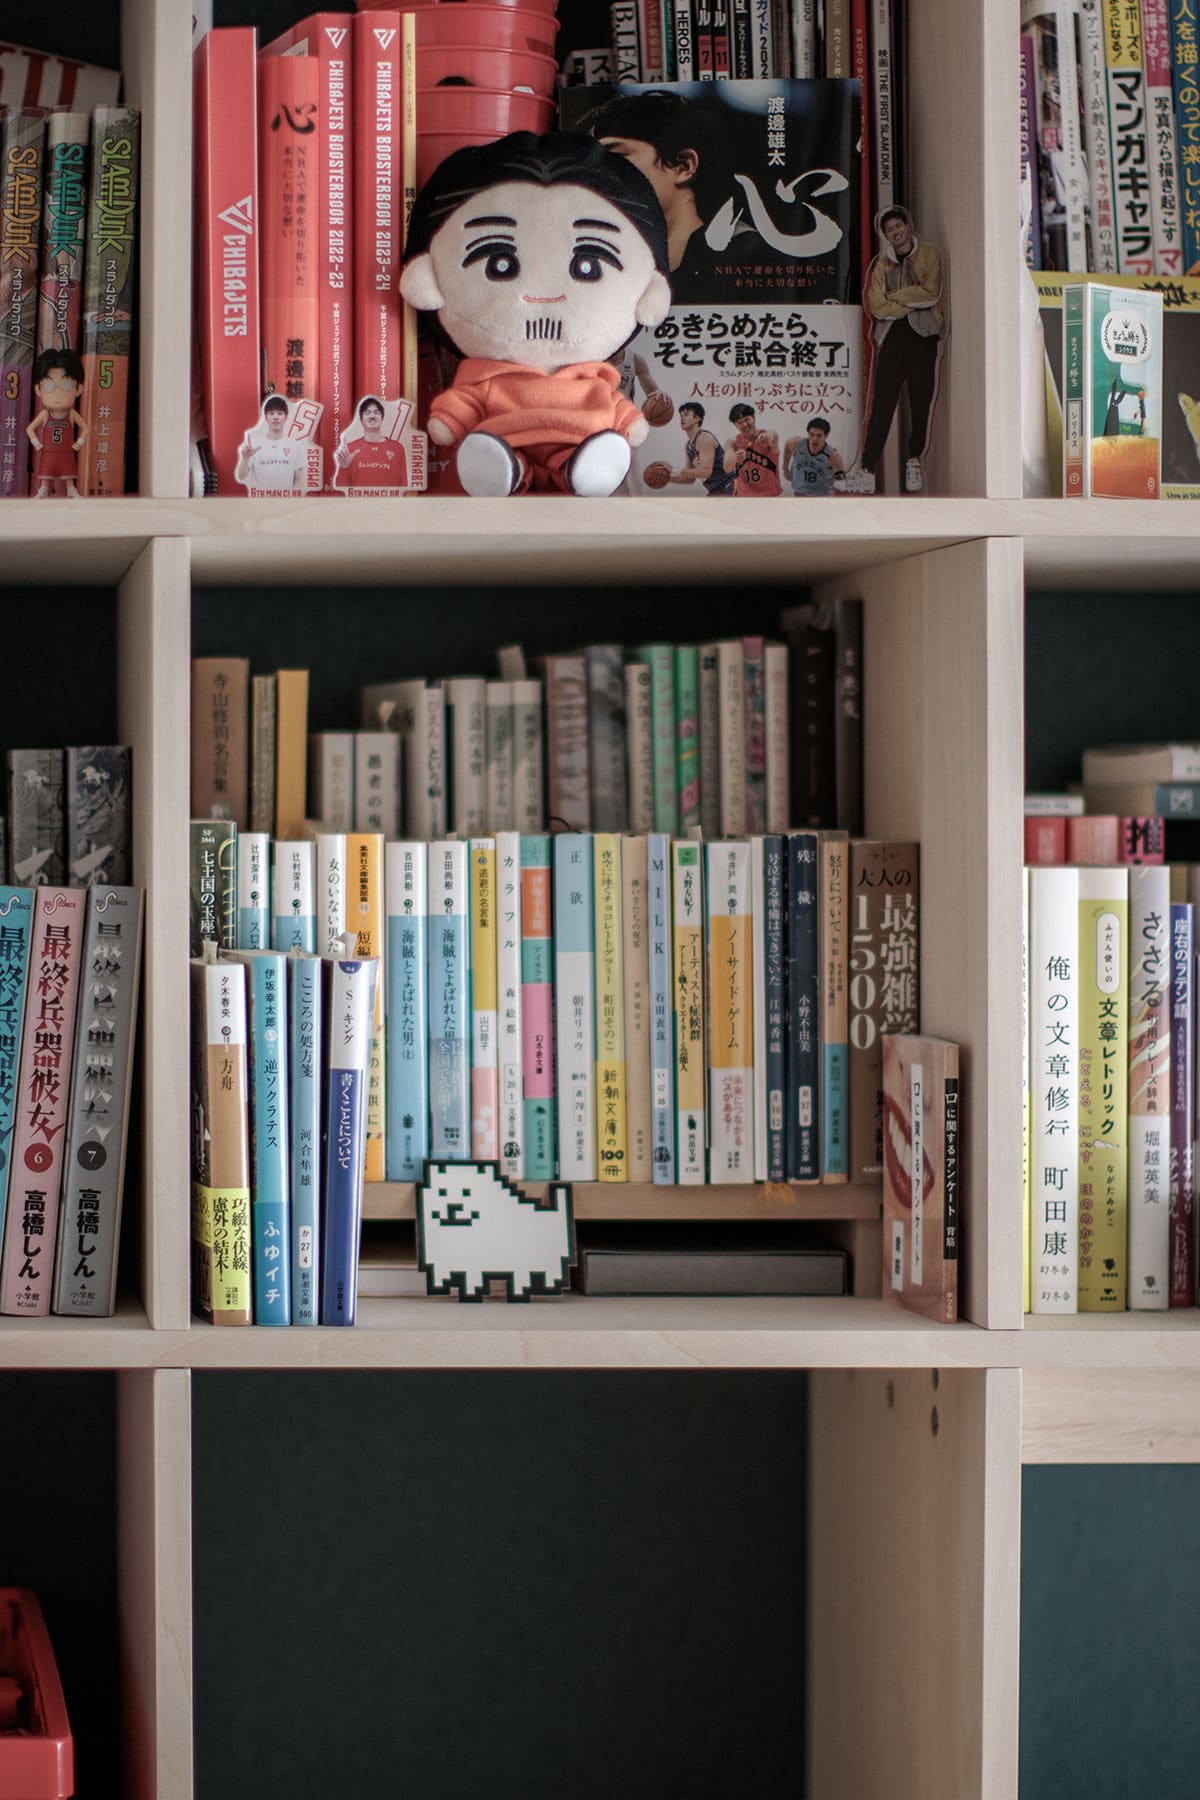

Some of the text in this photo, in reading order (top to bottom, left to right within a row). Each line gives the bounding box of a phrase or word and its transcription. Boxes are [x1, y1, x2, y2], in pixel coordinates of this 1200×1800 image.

[677, 10, 690, 64] HEROES
[702, 50, 710, 64] 7
[716, 51, 727, 65] 11
[756, 0, 768, 80] ガイド202
[271, 104, 317, 134] 心
[767, 97, 786, 166] 渡邊雄太
[880, 95, 889, 122] FIRST
[329, 60, 344, 289] CHIBAJETS BOOSTERBOOK 2022-23
[376, 61, 391, 291] CHIBAJETS BOOSTERBOOK 2023-24
[1112, 72, 1151, 257] マンガキャラ
[1155, 97, 1177, 242] 写真から描き起こす
[704, 168, 850, 258] 心
[11, 268, 23, 336] スラムダンク
[57, 264, 69, 333] スラムダンク
[105, 259, 118, 328] スラムダンク
[223, 235, 247, 337] CHIBAJETS
[99, 360, 113, 390] 5
[653, 341, 850, 369] そこで試合終了」
[5, 371, 19, 400] 3
[690, 382, 853, 399] 人生の崖っぷちに立つ、
[754, 400, 853, 414] すべての人へ。
[288, 399, 320, 440] 5
[307, 449, 319, 488] SEGAWA
[411, 435, 423, 487] WATANABE
[744, 468, 761, 483] 18
[803, 470, 818, 484] 18
[201, 850, 215, 934] 七王国の玉座
[292, 852, 301, 891] 辻村深月
[404, 852, 413, 890] 百田尚樹
[445, 851, 453, 889] 百田尚樹
[569, 851, 583, 905] 正欲
[504, 856, 515, 949] カラフル
[250, 923, 260, 950] スロ
[221, 976, 231, 1018] 夕木春央
[265, 969, 276, 1027] 伊坂幸太郎
[573, 995, 584, 1051] 朝井リョウ
[604, 995, 615, 1051] 町田そのこ
[655, 991, 665, 1041] 石田衣良
[799, 995, 811, 1052] 小野不由美
[28, 923, 72, 1144] 最終兵器彼女
[301, 977, 313, 1078] こころの処方箋
[1044, 956, 1072, 1135] 俺の文章修行
[220, 1060, 234, 1091] 方舟
[1097, 998, 1119, 1135] 文章レトリック
[1147, 1015, 1158, 1111] 引用フレーズ辞典
[264, 1060, 277, 1148] 逆ソクラテス
[338, 1073, 353, 1168] 書くことについて
[34, 1151, 42, 1164] 6
[88, 1151, 97, 1162] 7
[300, 1129, 312, 1186] 河合隼雄
[945, 1093, 958, 1216] 口に関するアンケート
[1144, 1131, 1160, 1204] 堀越英美
[1042, 1167, 1069, 1256] 町田康
[1106, 1165, 1116, 1227] ながたみかこ
[18, 1190, 47, 1280] 高橋しん
[73, 1188, 102, 1279] 高橋しん
[300, 1243, 310, 1251] 27
[303, 1256, 308, 1264] 4
[264, 1221, 280, 1304] ふゆイチ
